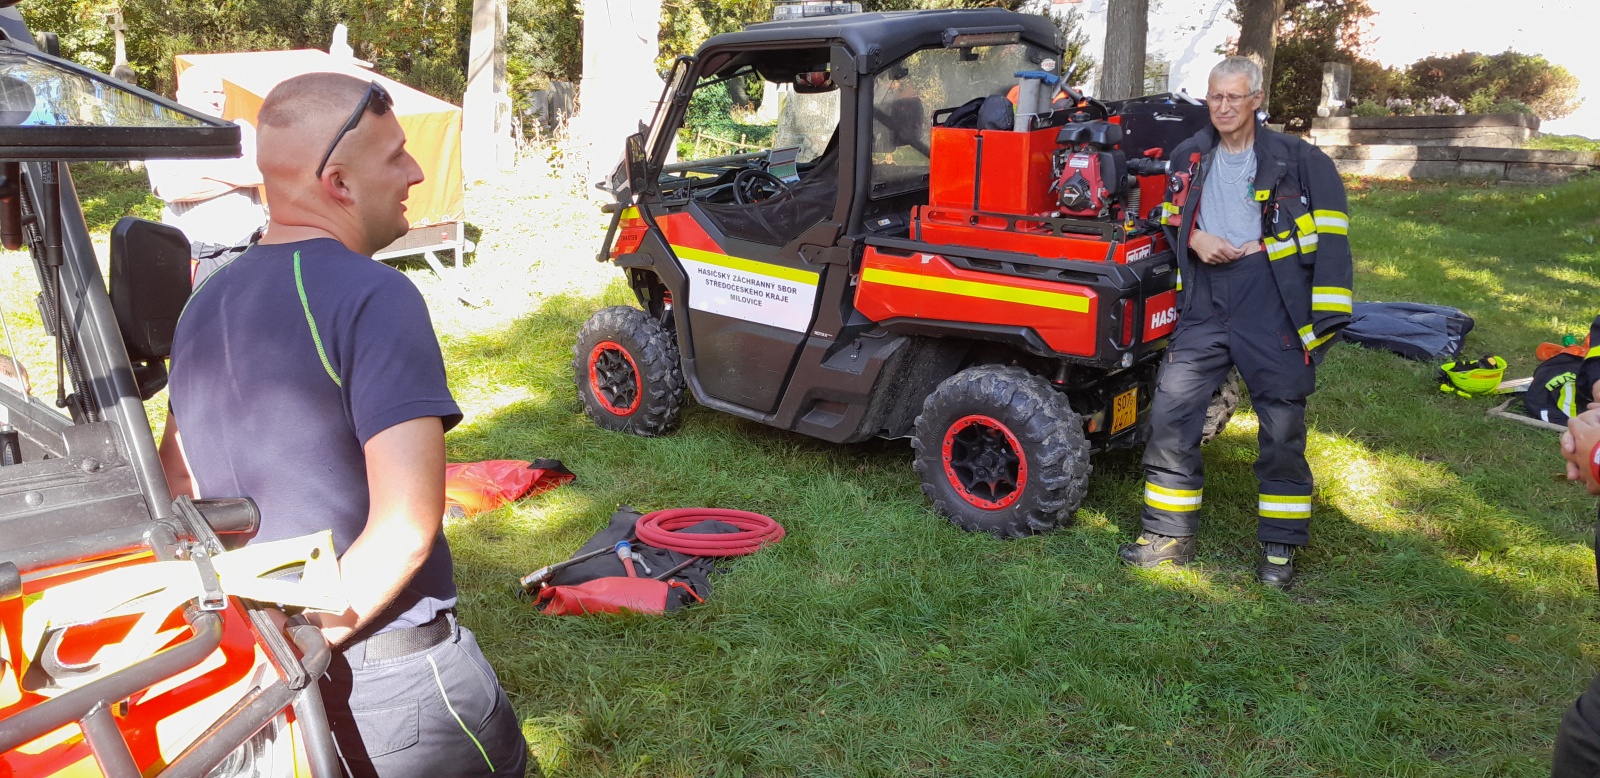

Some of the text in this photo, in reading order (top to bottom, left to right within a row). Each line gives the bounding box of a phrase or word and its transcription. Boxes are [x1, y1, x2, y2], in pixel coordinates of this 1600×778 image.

[697, 267, 798, 295] HASIČSKÝ ZÁCHRANNÝ SBOR
[705, 278, 789, 303] STŘEDOČESKÉHO KRAJE
[730, 293, 762, 307] MILOVICE
